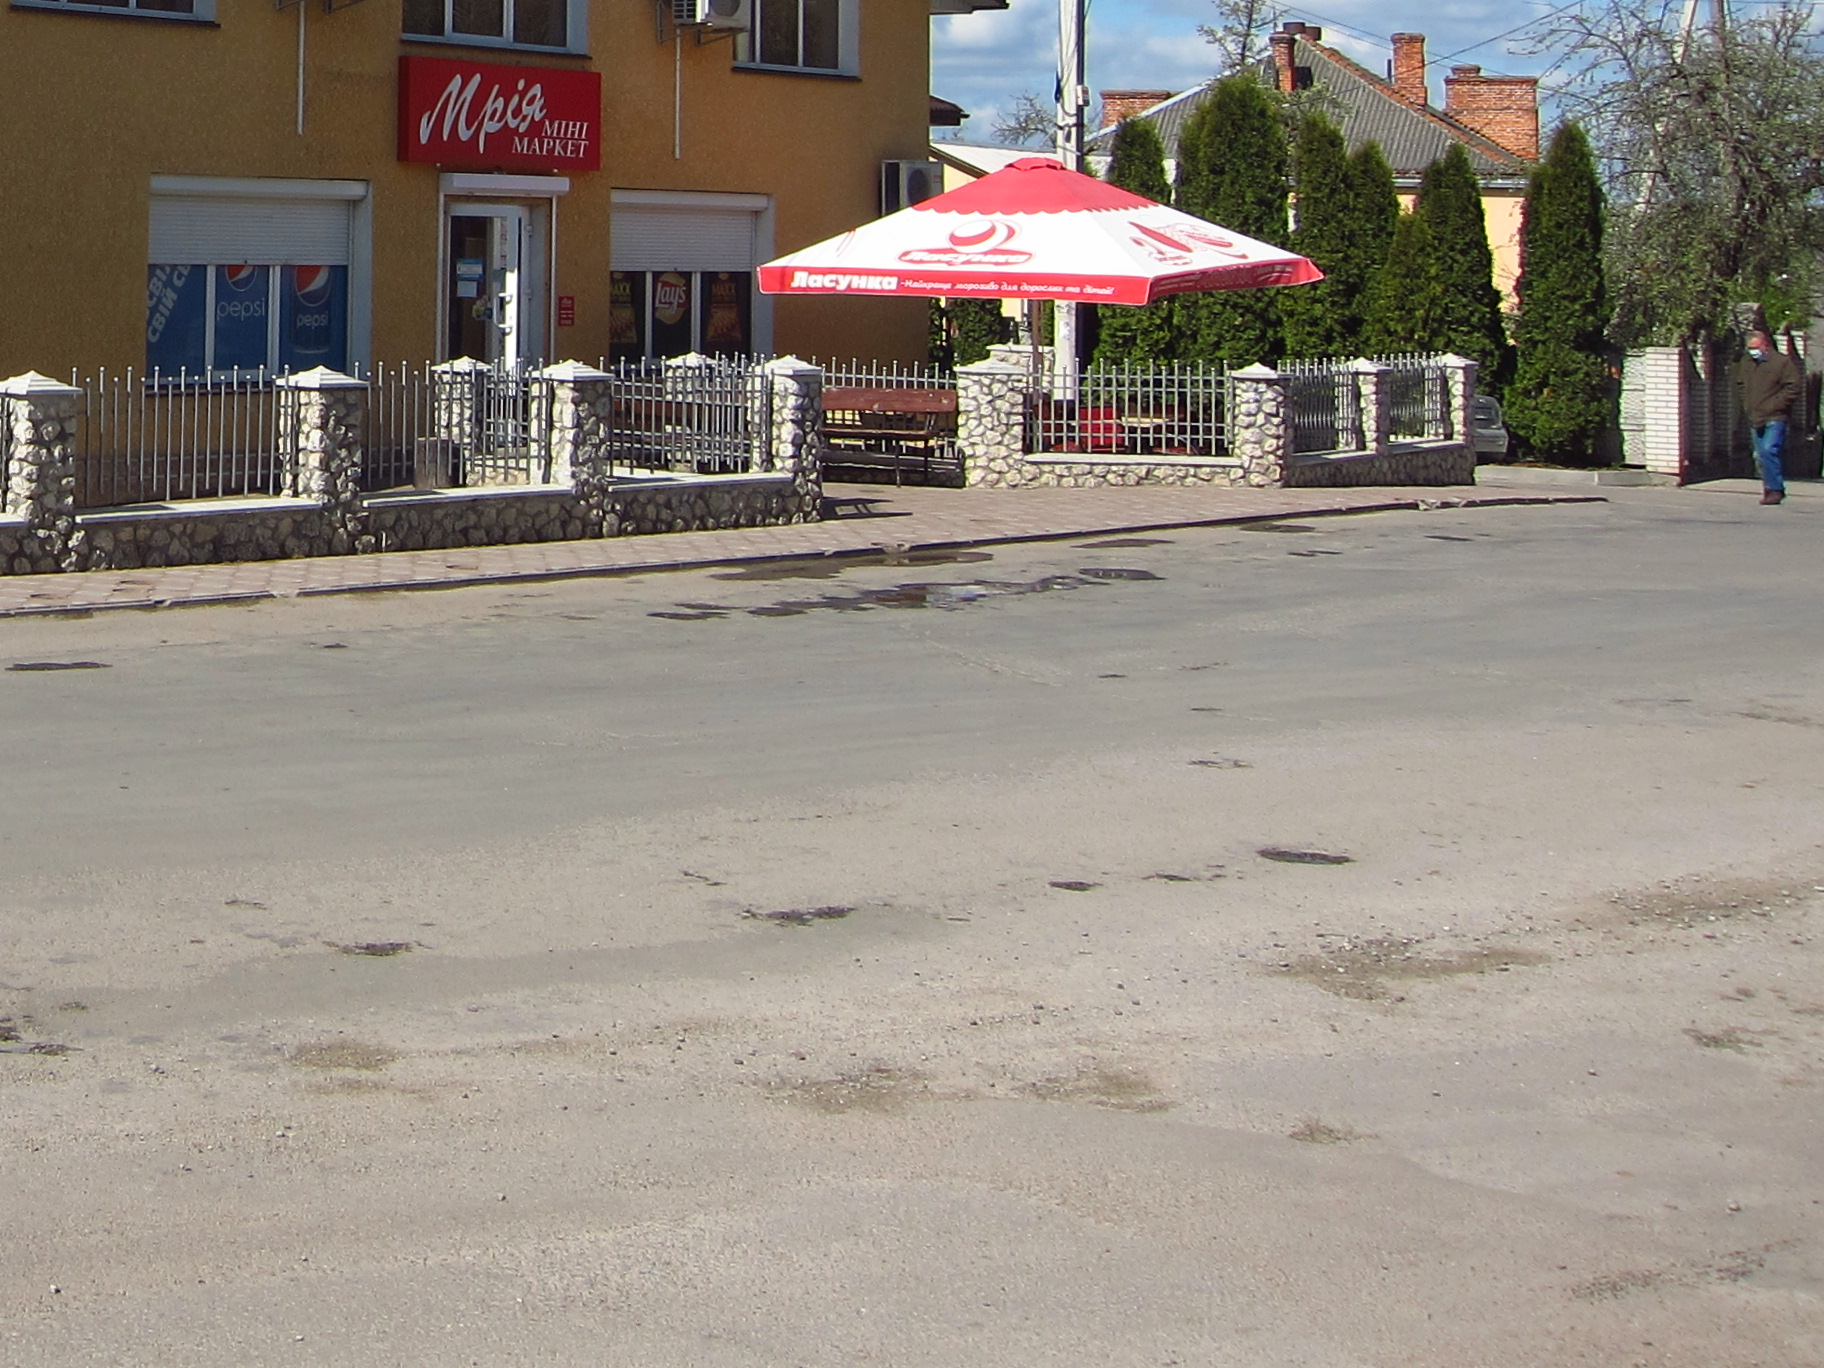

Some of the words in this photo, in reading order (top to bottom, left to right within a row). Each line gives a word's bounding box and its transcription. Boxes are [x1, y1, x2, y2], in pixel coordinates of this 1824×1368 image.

[419, 73, 548, 154] Мрія
[542, 119, 589, 140] МІНІ
[512, 137, 589, 158] МАРКЕТ
[790, 271, 898, 291] Ласунка
[216, 297, 266, 322] pepsi
[296, 310, 329, 330] pepsi
